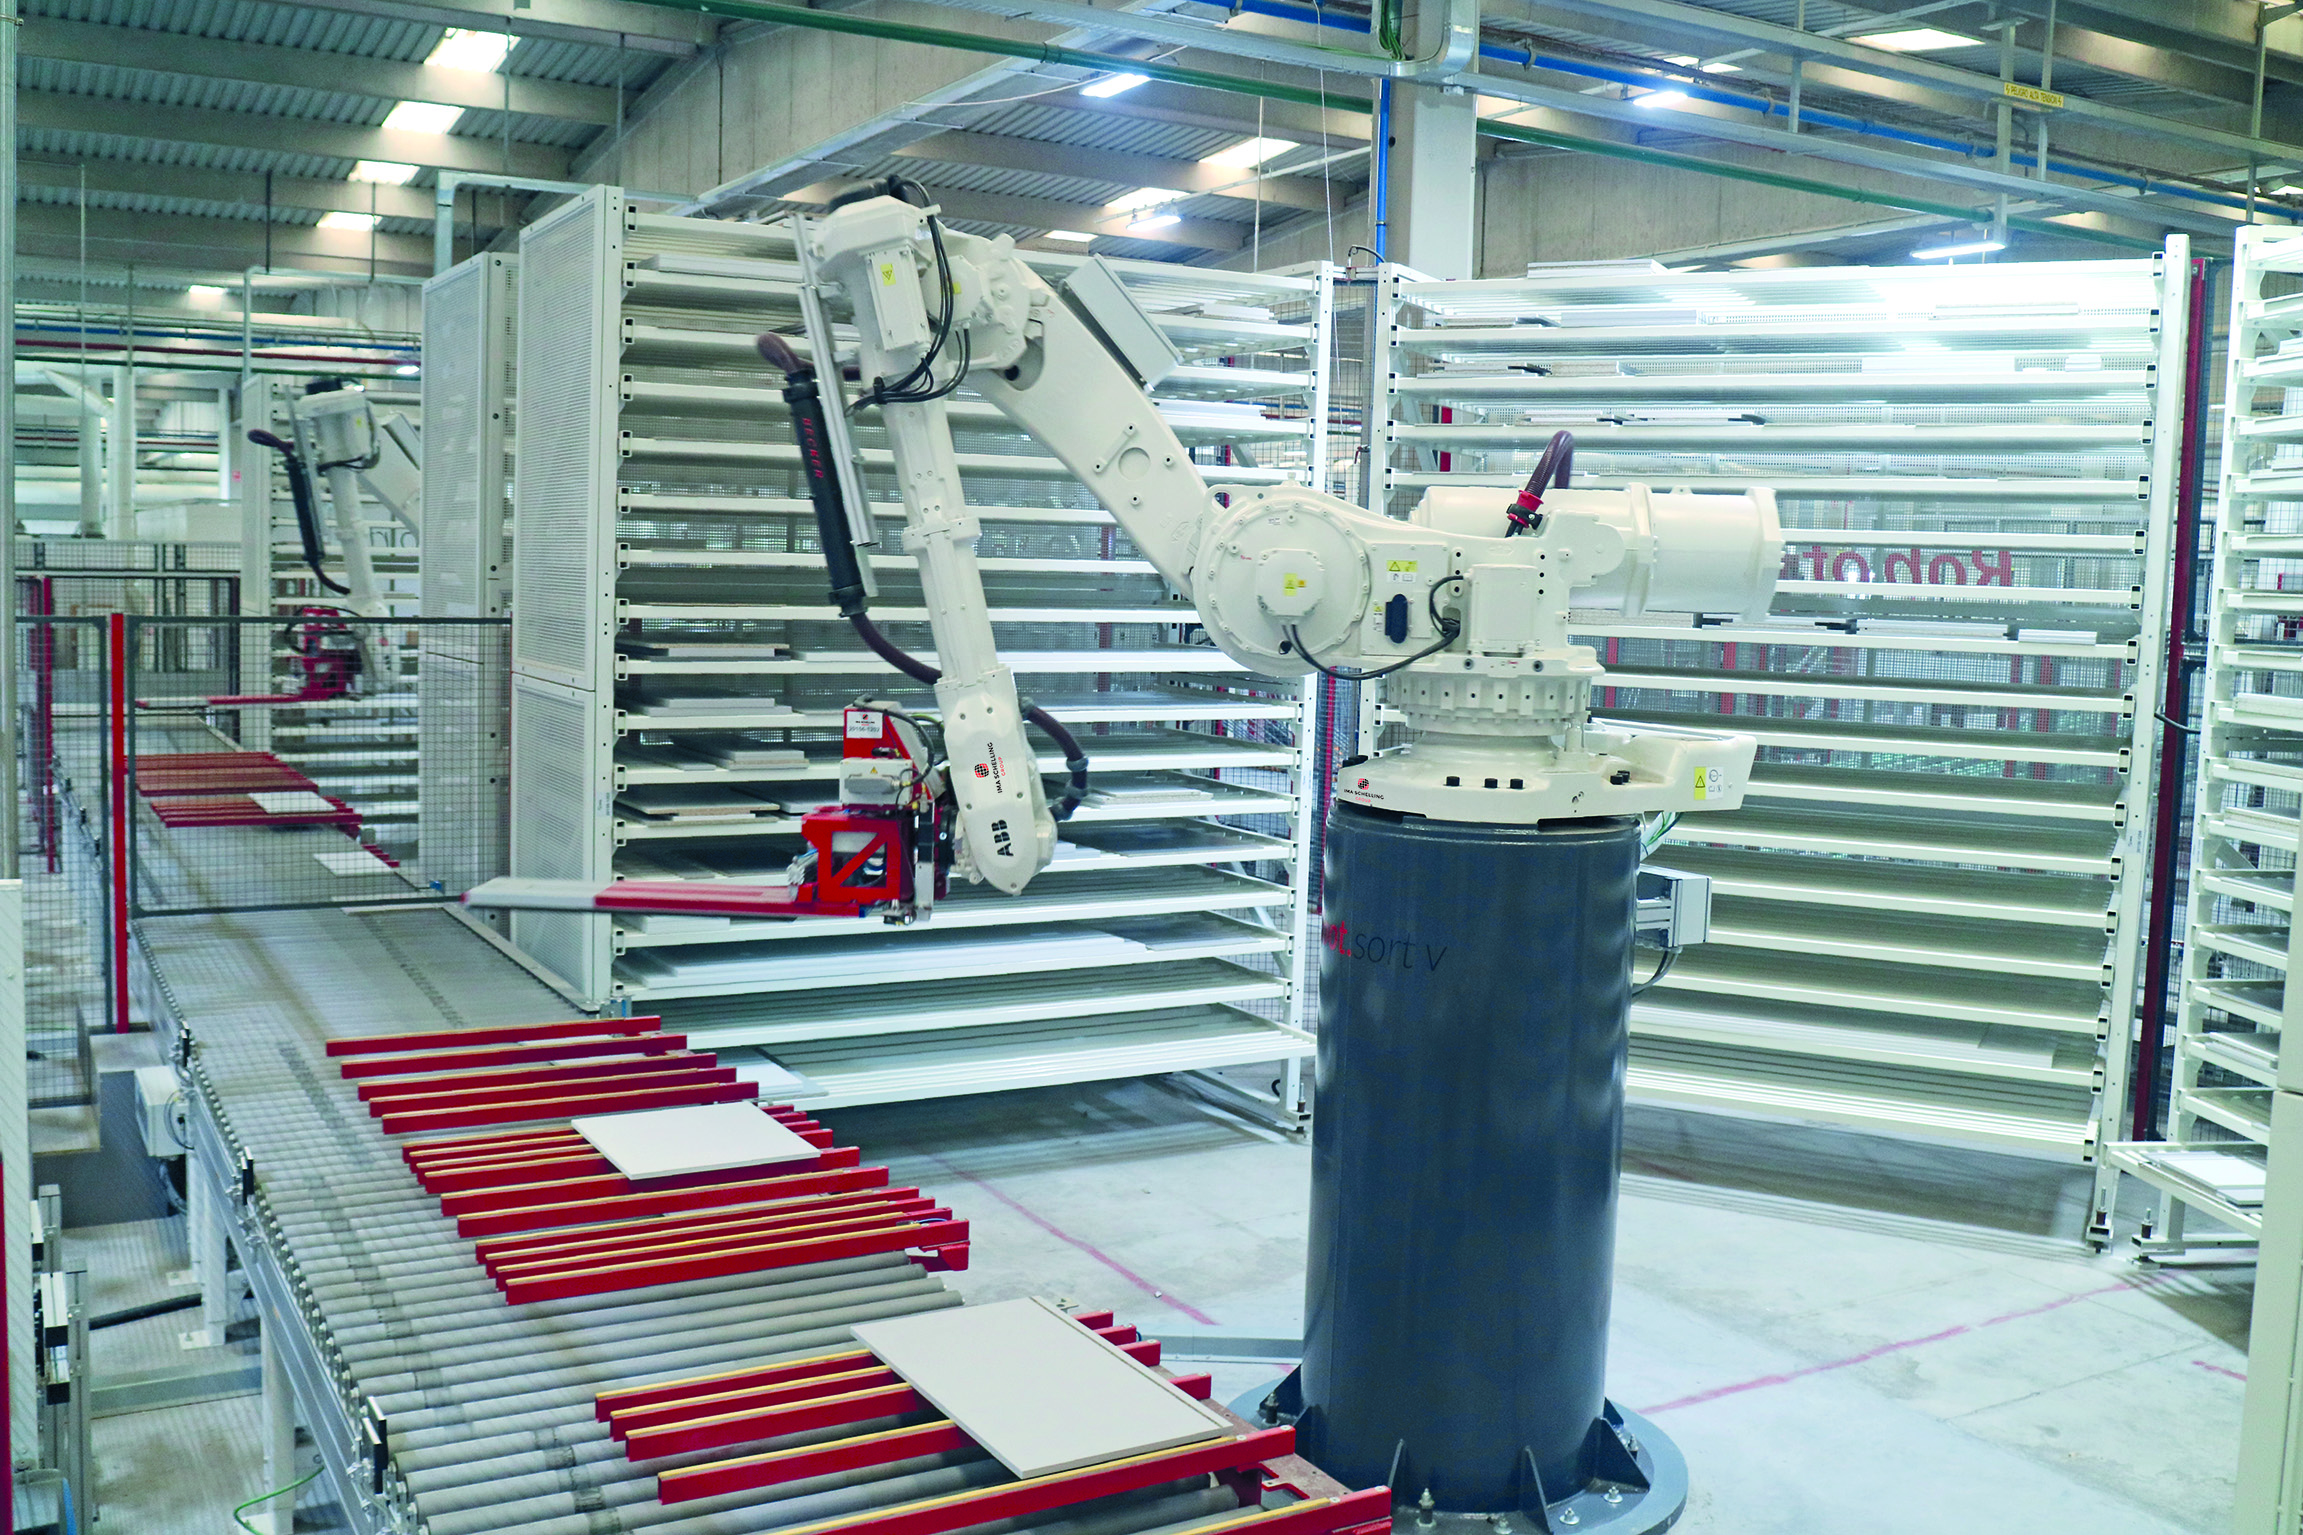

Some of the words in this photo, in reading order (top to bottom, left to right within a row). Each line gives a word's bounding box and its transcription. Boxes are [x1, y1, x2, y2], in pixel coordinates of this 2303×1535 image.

[802, 417, 824, 478] BECKER
[987, 742, 1000, 779] SCHELLING
[998, 756, 1006, 776] GROUP
[995, 780, 1003, 794] IMA
[1354, 790, 1384, 800] SCHELLING
[991, 819, 1014, 857] ABB
